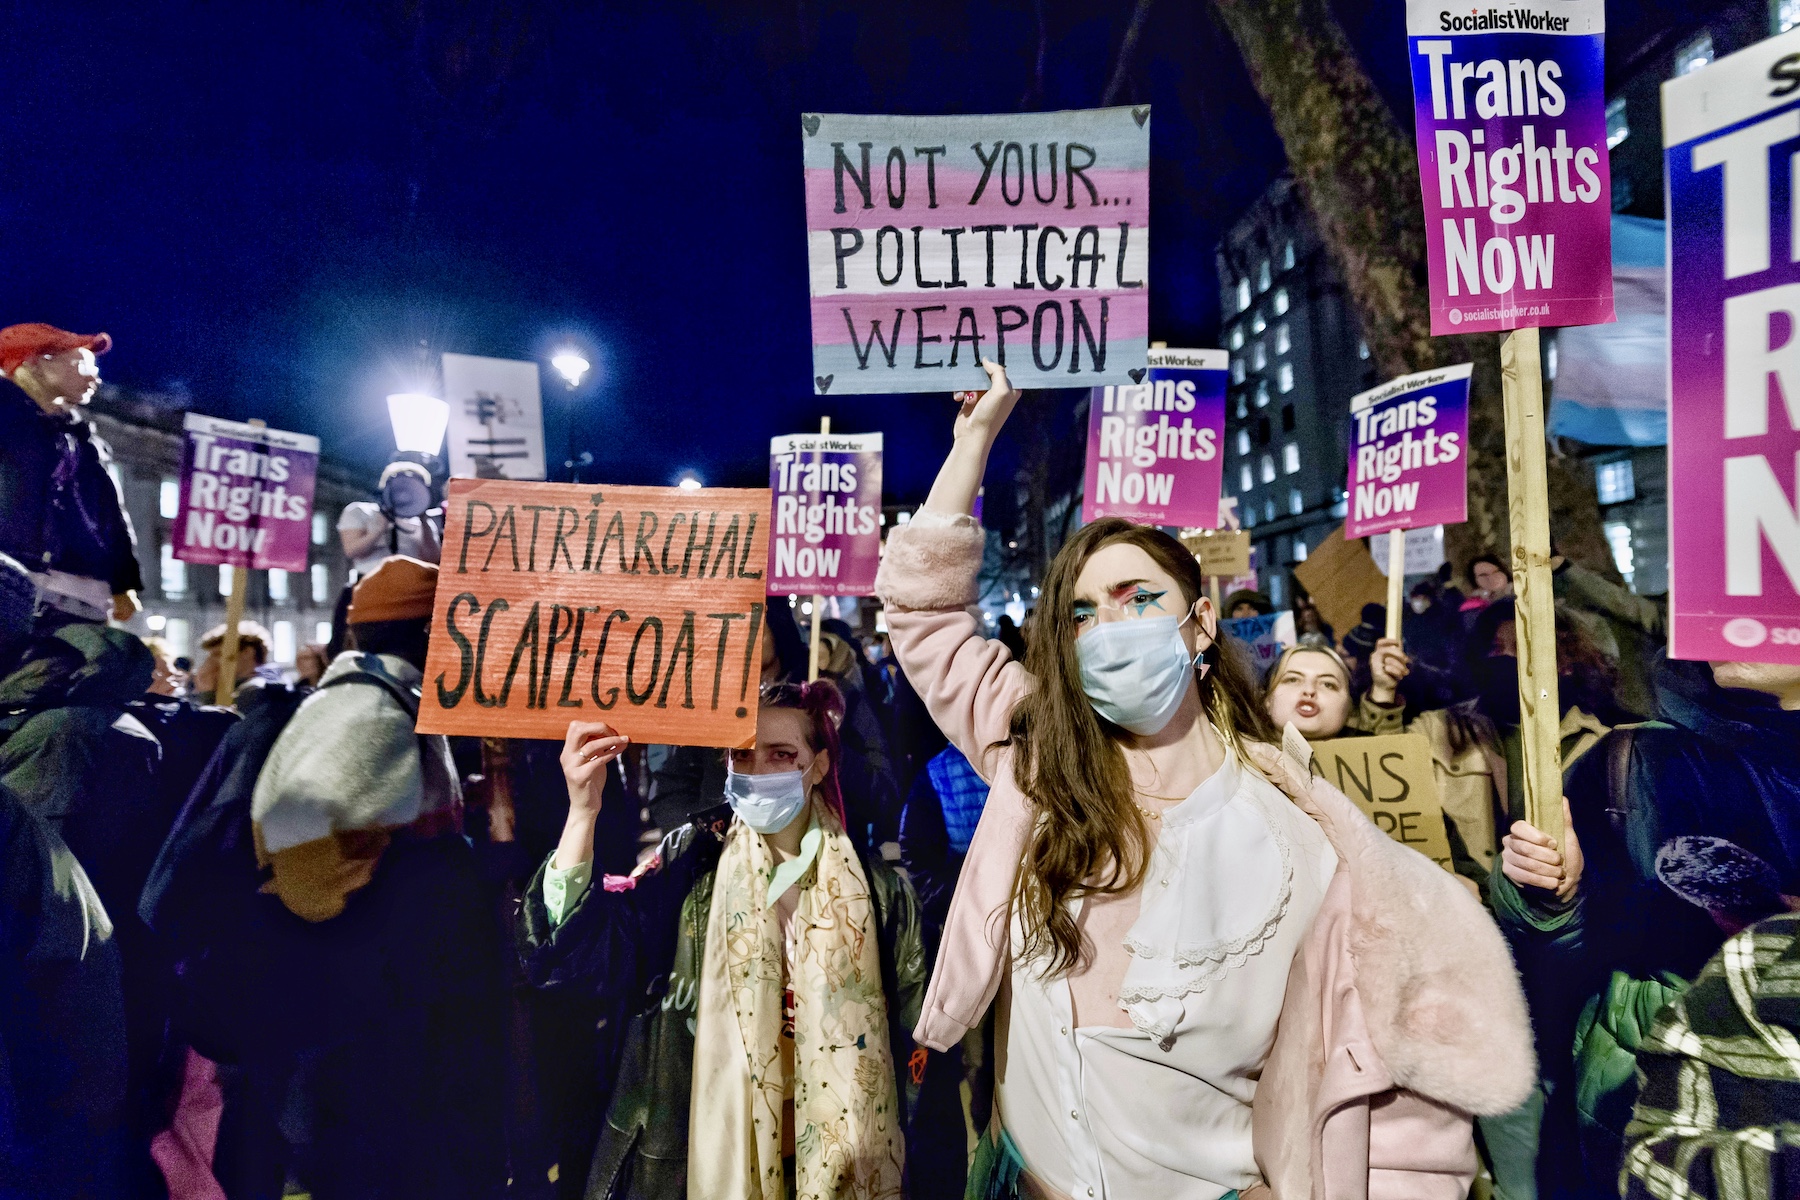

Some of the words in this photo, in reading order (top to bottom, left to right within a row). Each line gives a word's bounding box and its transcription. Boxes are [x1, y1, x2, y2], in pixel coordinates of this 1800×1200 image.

[1417, 40, 1566, 120] Trans
[830, 141, 946, 214] NOT
[967, 140, 1132, 210] YOUR...
[1435, 125, 1601, 224] Rights
[830, 220, 1145, 292] POLITICAL
[1442, 218, 1555, 297] Now
[840, 297, 1110, 374] WEAPON
[1463, 302, 1551, 322] socialistworker.co.uk
[1165, 354, 1206, 367] Worker
[1407, 374, 1447, 390] Worker
[1098, 414, 1217, 468] Rights
[1354, 395, 1438, 446] Trans
[189, 432, 290, 482] Trans
[775, 453, 857, 493] Trans
[1355, 428, 1460, 484] Rights
[188, 471, 308, 521] Rights
[1095, 461, 1175, 505] Now
[1354, 481, 1420, 522] Now
[184, 510, 267, 554] Now
[457, 493, 764, 580] PATRIARCHAL
[776, 494, 876, 544] Rights
[774, 537, 842, 578] Now
[434, 592, 765, 719] SCAPEGOAT!
